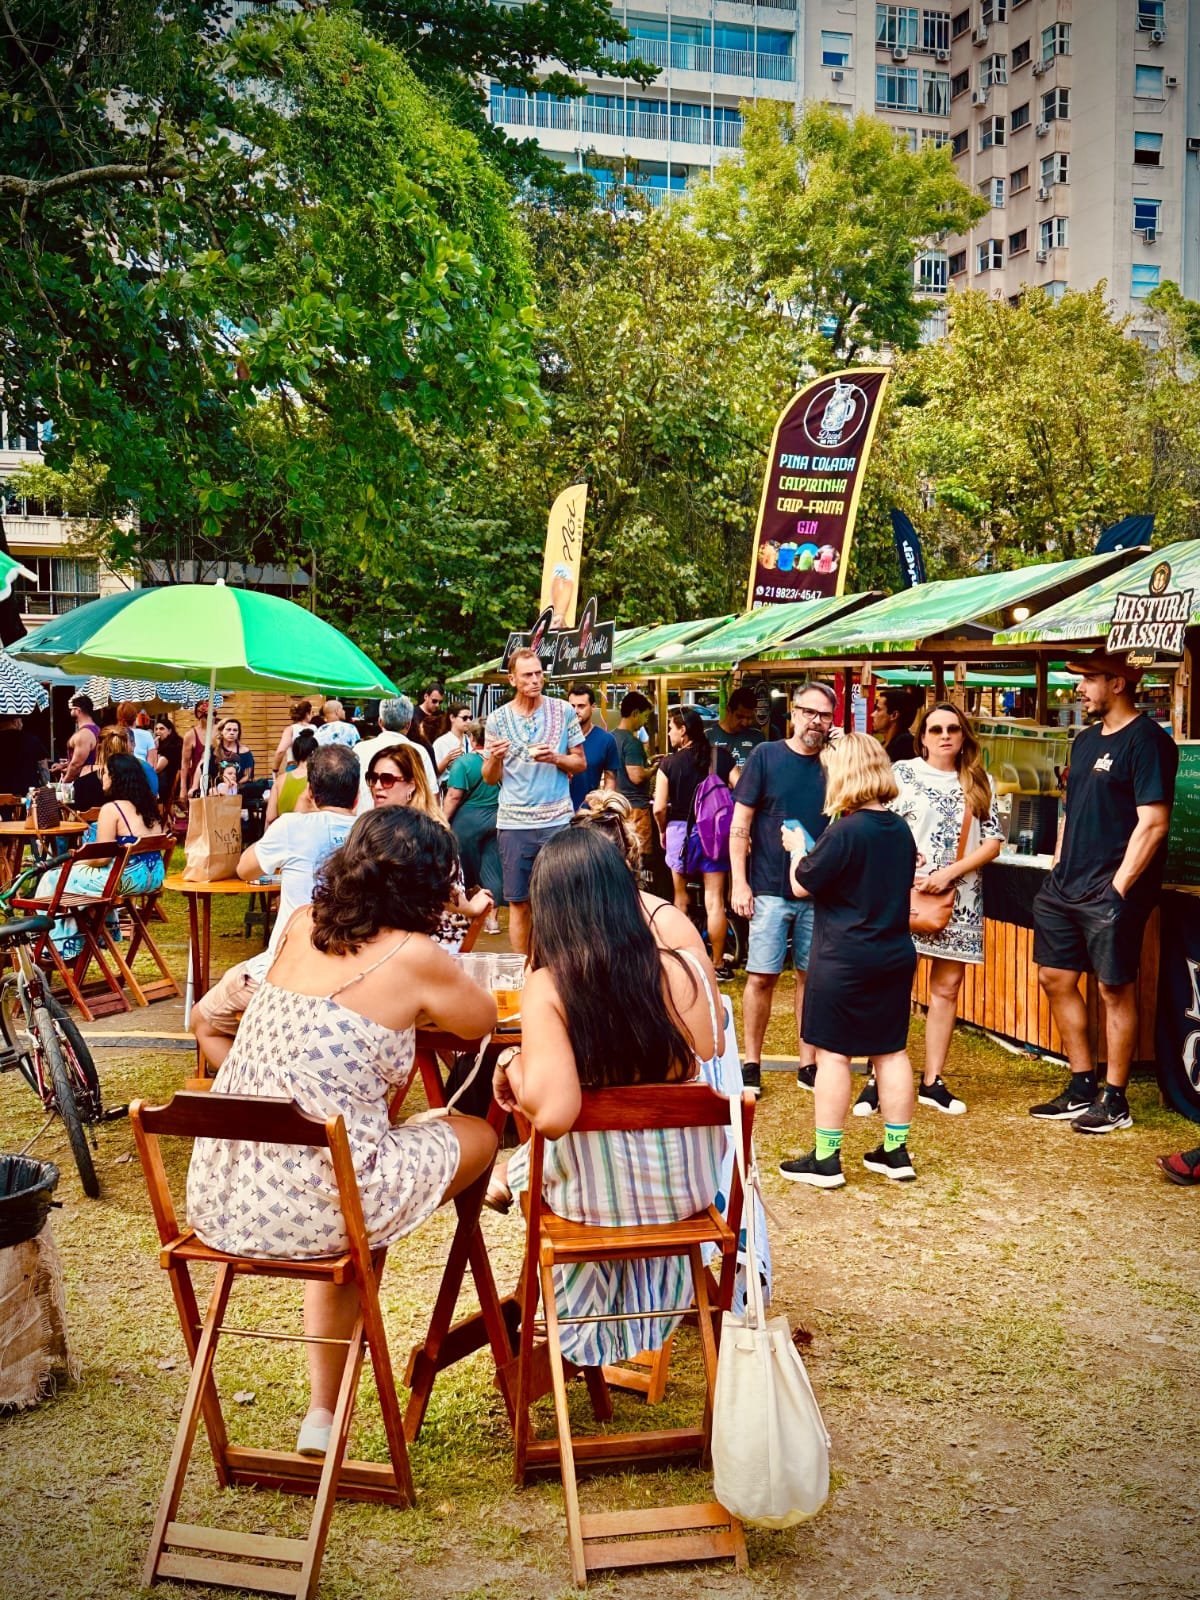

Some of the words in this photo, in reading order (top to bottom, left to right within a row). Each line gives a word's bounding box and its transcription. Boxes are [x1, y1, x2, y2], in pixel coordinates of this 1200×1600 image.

[779, 454, 809, 470] PINA
[812, 457, 856, 471] COLADA
[779, 476, 847, 493] CAIPIRINHA
[777, 497, 844, 515] CAIP-FRUTA
[797, 521, 818, 534] GIN
[765, 586, 774, 597] 21
[1112, 591, 1191, 622] MISTURA
[1107, 622, 1184, 652] CLÁSSICA
